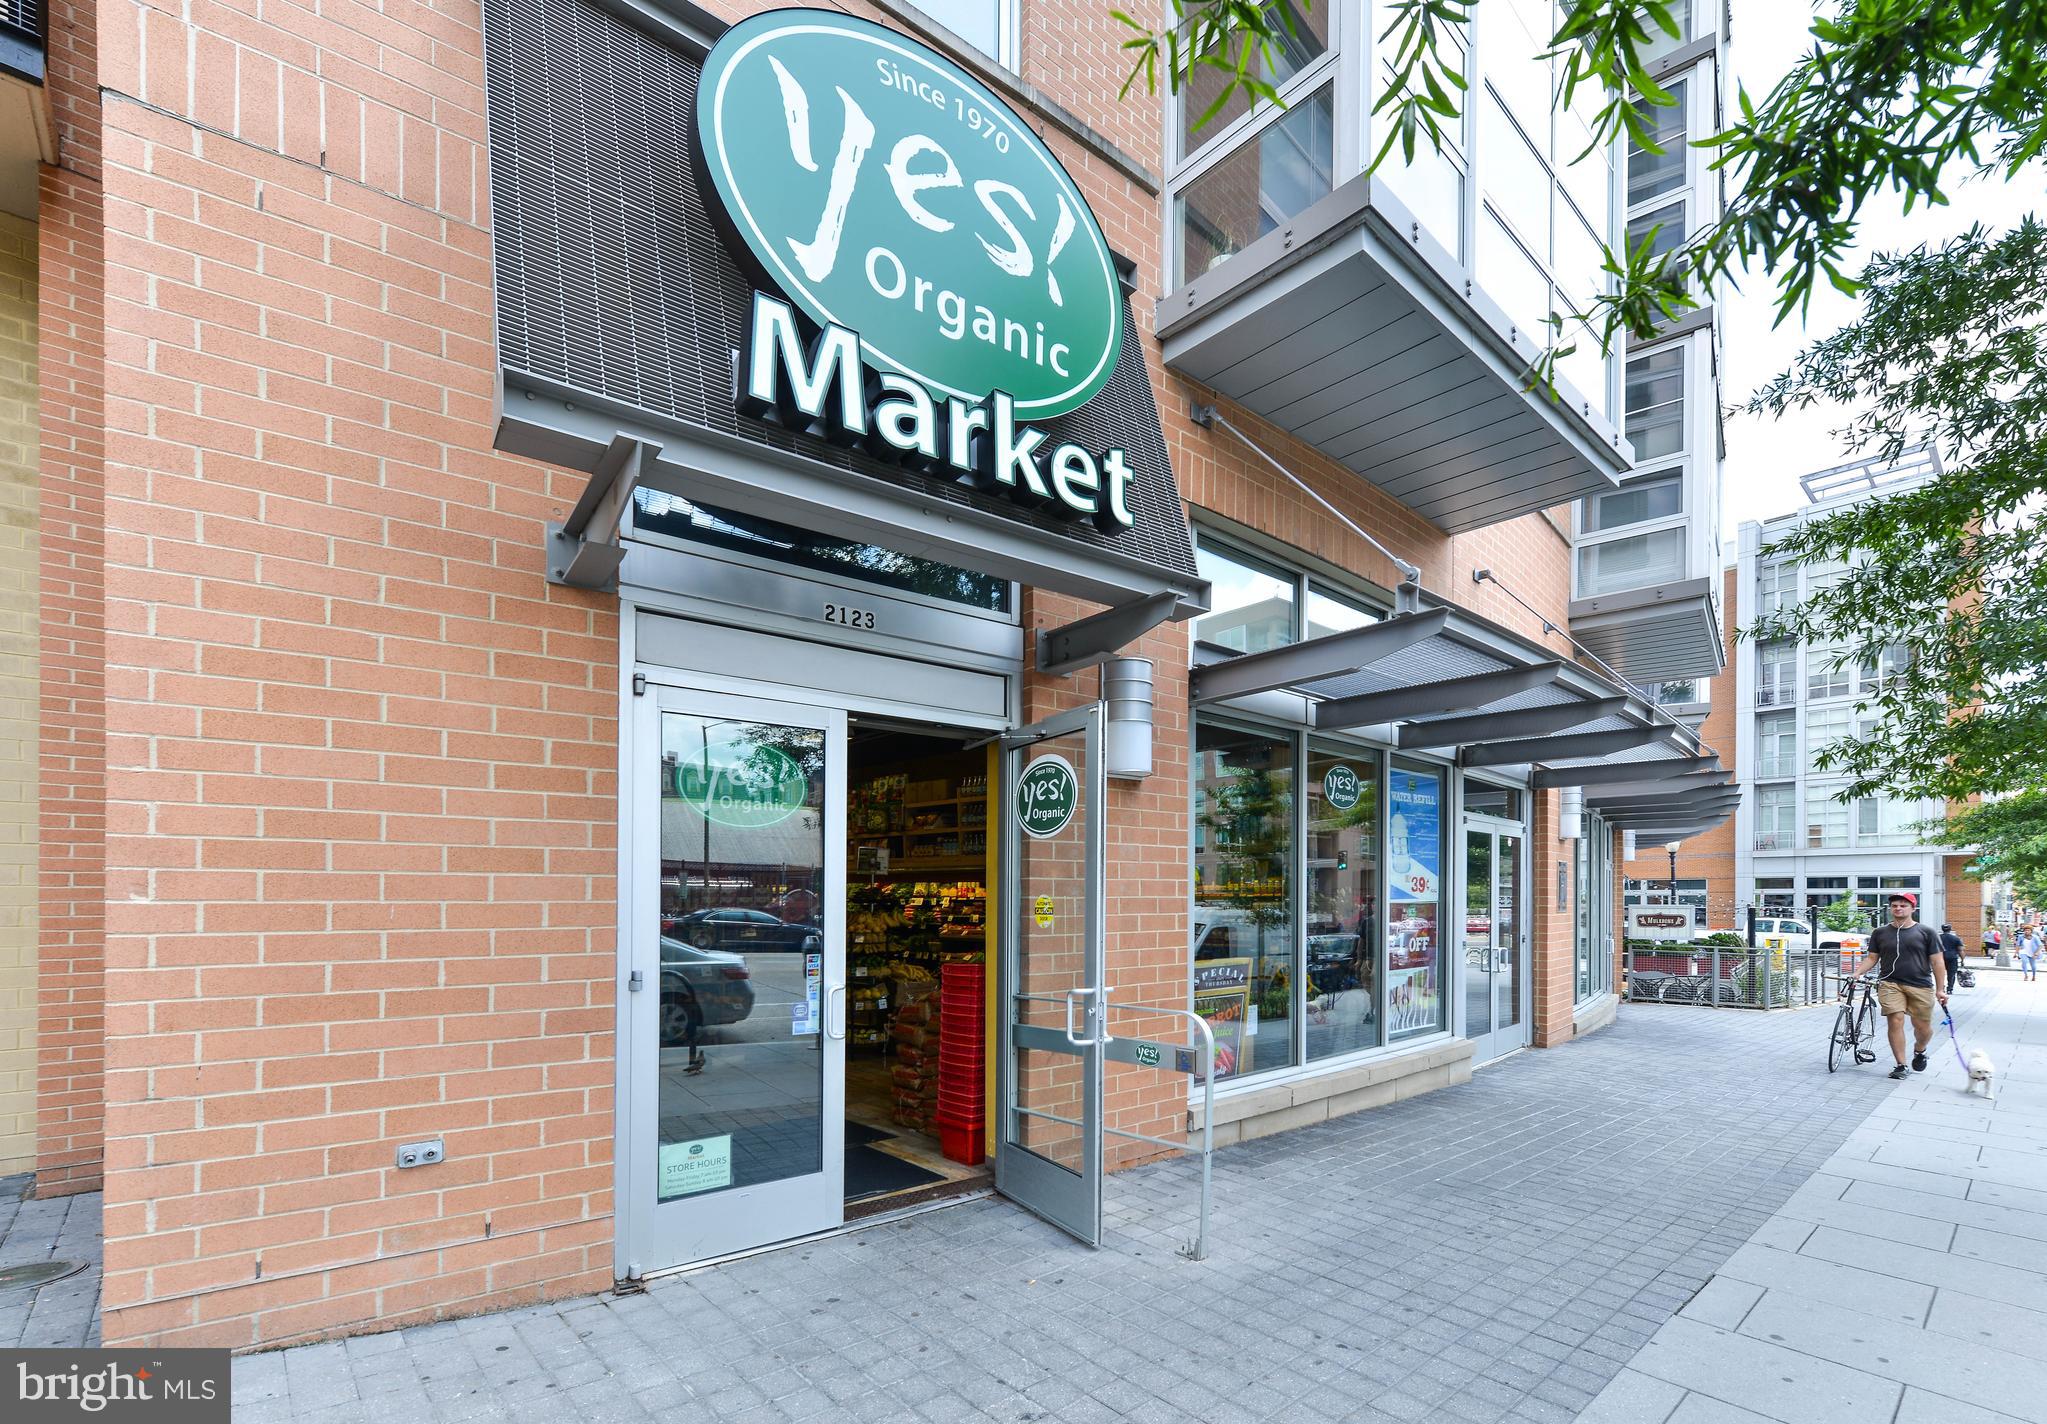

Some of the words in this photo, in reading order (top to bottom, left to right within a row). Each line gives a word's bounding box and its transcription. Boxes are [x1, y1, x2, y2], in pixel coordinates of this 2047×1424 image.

[876, 57, 946, 110] Since
[954, 98, 1010, 154] 1970
[767, 54, 1076, 307] yes!
[865, 246, 1070, 378] Organic
[748, 289, 1136, 528] Market
[825, 604, 875, 629] 2123
[1023, 772, 1067, 822] yes!
[1328, 775, 1356, 801] yes!
[1335, 792, 1356, 802] Organic
[1390, 791, 1412, 803] WATER
[1412, 794, 1436, 806] REFILL
[720, 795, 789, 814] Organic
[1032, 806, 1065, 821] Organic
[1409, 936, 1430, 952] OFF
[1138, 1046, 1158, 1060] yes!
[666, 1162, 695, 1174] STORE
[697, 1156, 727, 1169] HOURS
